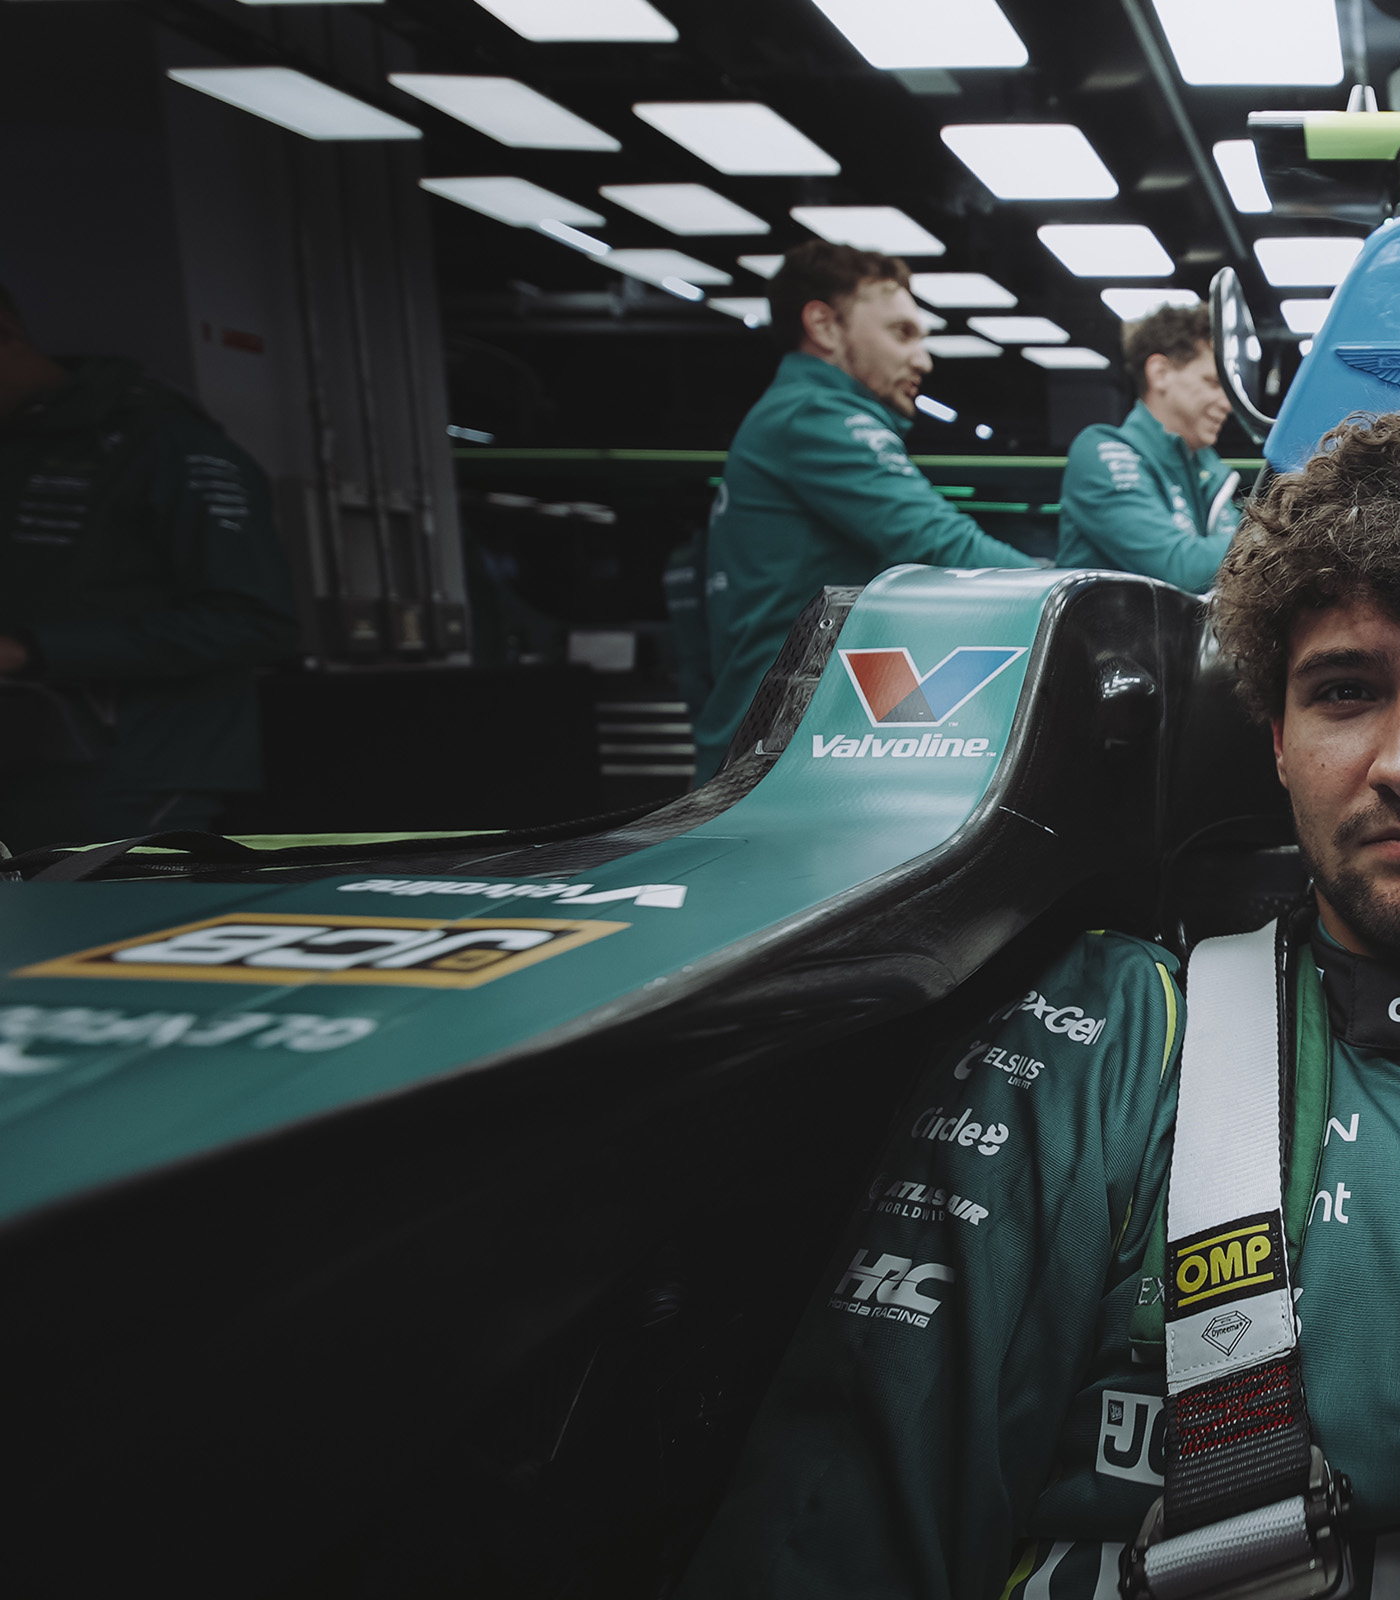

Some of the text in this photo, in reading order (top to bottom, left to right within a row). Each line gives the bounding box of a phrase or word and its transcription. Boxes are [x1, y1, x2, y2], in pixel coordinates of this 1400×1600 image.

[112, 925, 555, 970] JCB
[954, 1041, 1046, 1080] CELSIUS
[876, 1201, 946, 1222] WORLDWID
[834, 1248, 956, 1315] HRC
[1176, 1235, 1271, 1293] OMP
[870, 1304, 932, 1329] RACING
